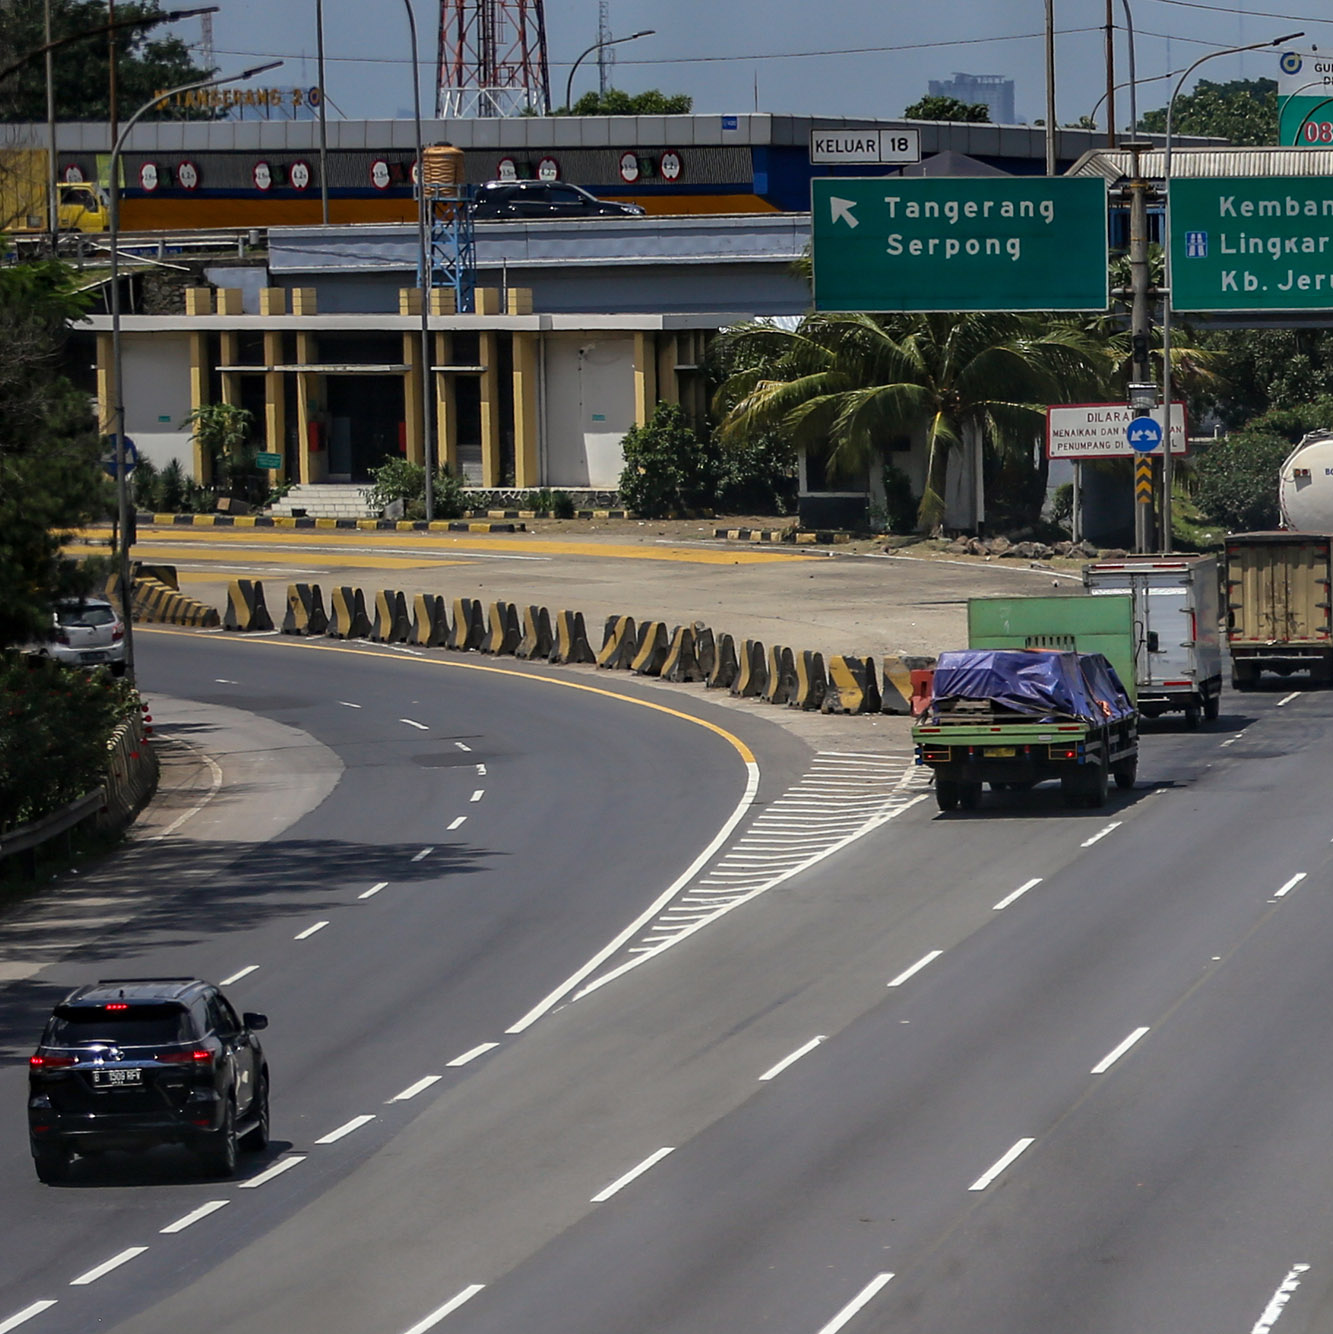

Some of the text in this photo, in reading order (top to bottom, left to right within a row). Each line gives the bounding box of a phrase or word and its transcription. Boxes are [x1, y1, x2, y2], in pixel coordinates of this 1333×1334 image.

[815, 137, 909, 153] KELUAR 18
[884, 196, 1055, 225] Tangerang
[886, 233, 1021, 262] Serpong
[1220, 232, 1330, 261] Lingkar
[1221, 271, 1268, 292] Kb.
[1052, 427, 1097, 438] MENAIKAN
[1100, 428, 1119, 436] DAN
[1057, 440, 1111, 451] PENUMPANG
[1114, 440, 1124, 449] DI
